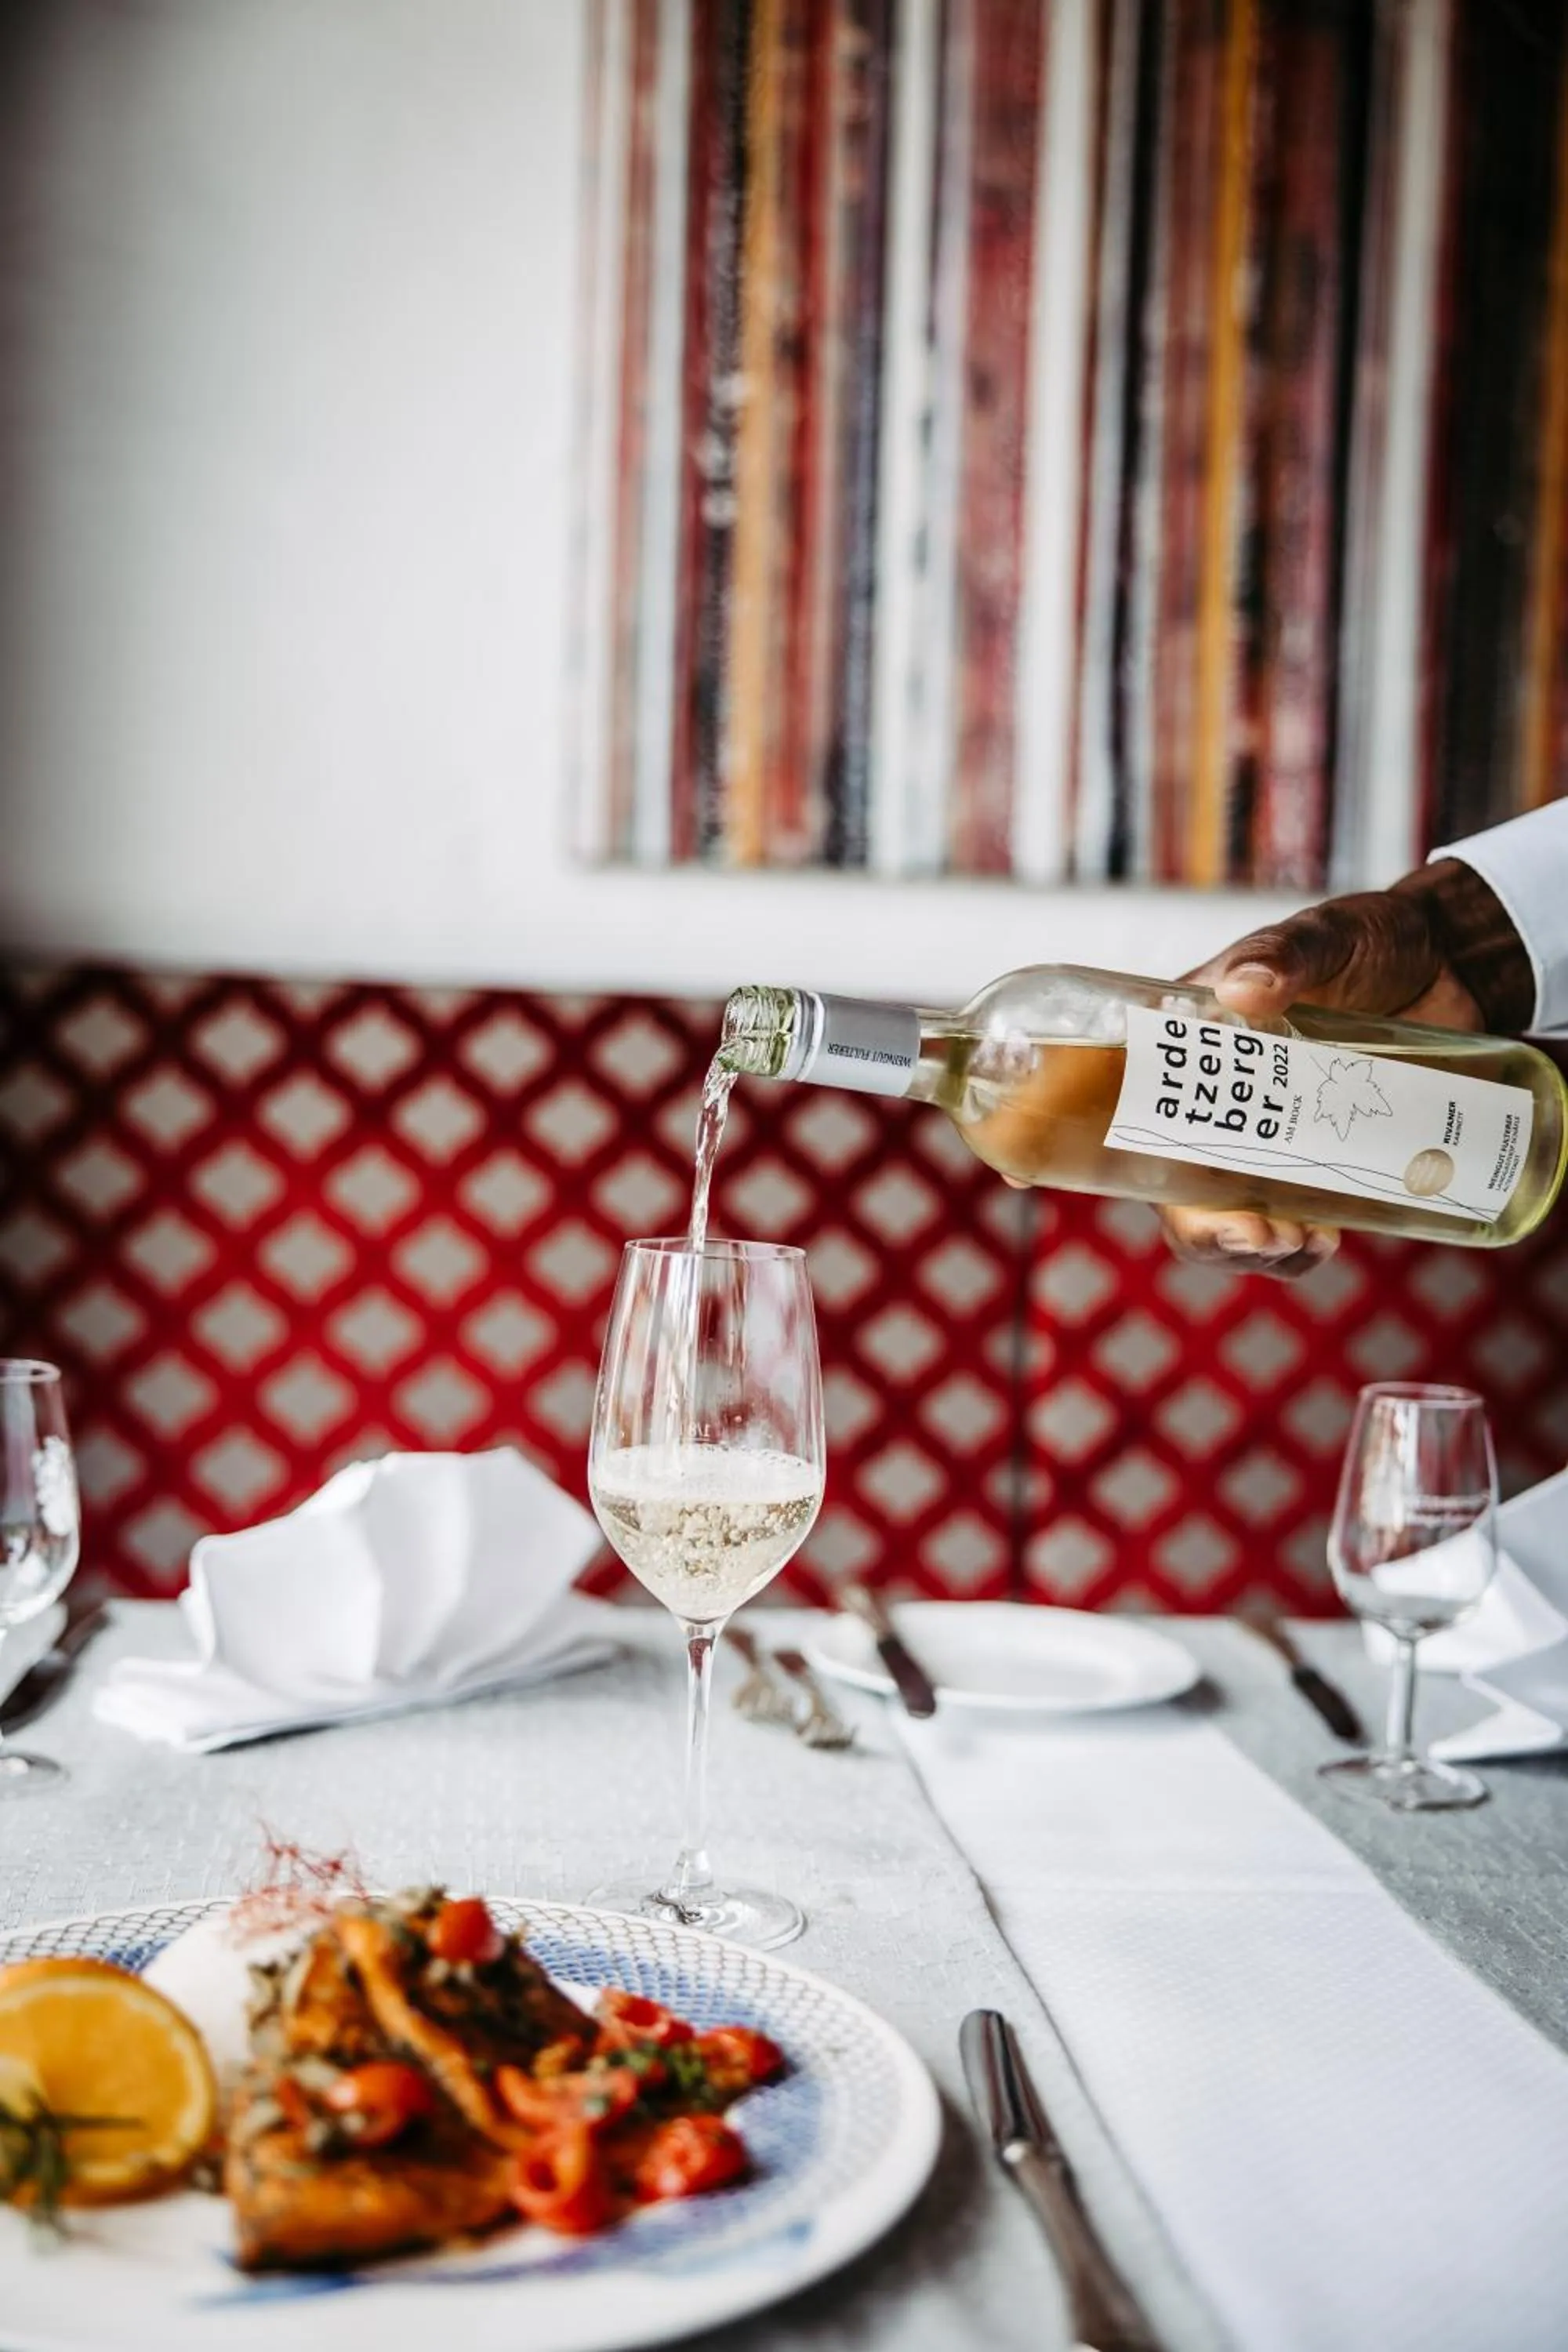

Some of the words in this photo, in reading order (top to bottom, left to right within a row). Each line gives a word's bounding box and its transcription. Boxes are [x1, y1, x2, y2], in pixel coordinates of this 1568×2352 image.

[873, 1051, 912, 1068] WEINGUT
[1156, 1019, 1187, 1118] arde
[1185, 1026, 1221, 1124] tzen
[1214, 1033, 1264, 1132] berg
[1256, 1095, 1283, 1139] er
[1273, 1044, 1288, 1088] 2022
[1443, 1102, 1456, 1144] RIVANER
[1487, 1153, 1505, 1189] WEINGUT
